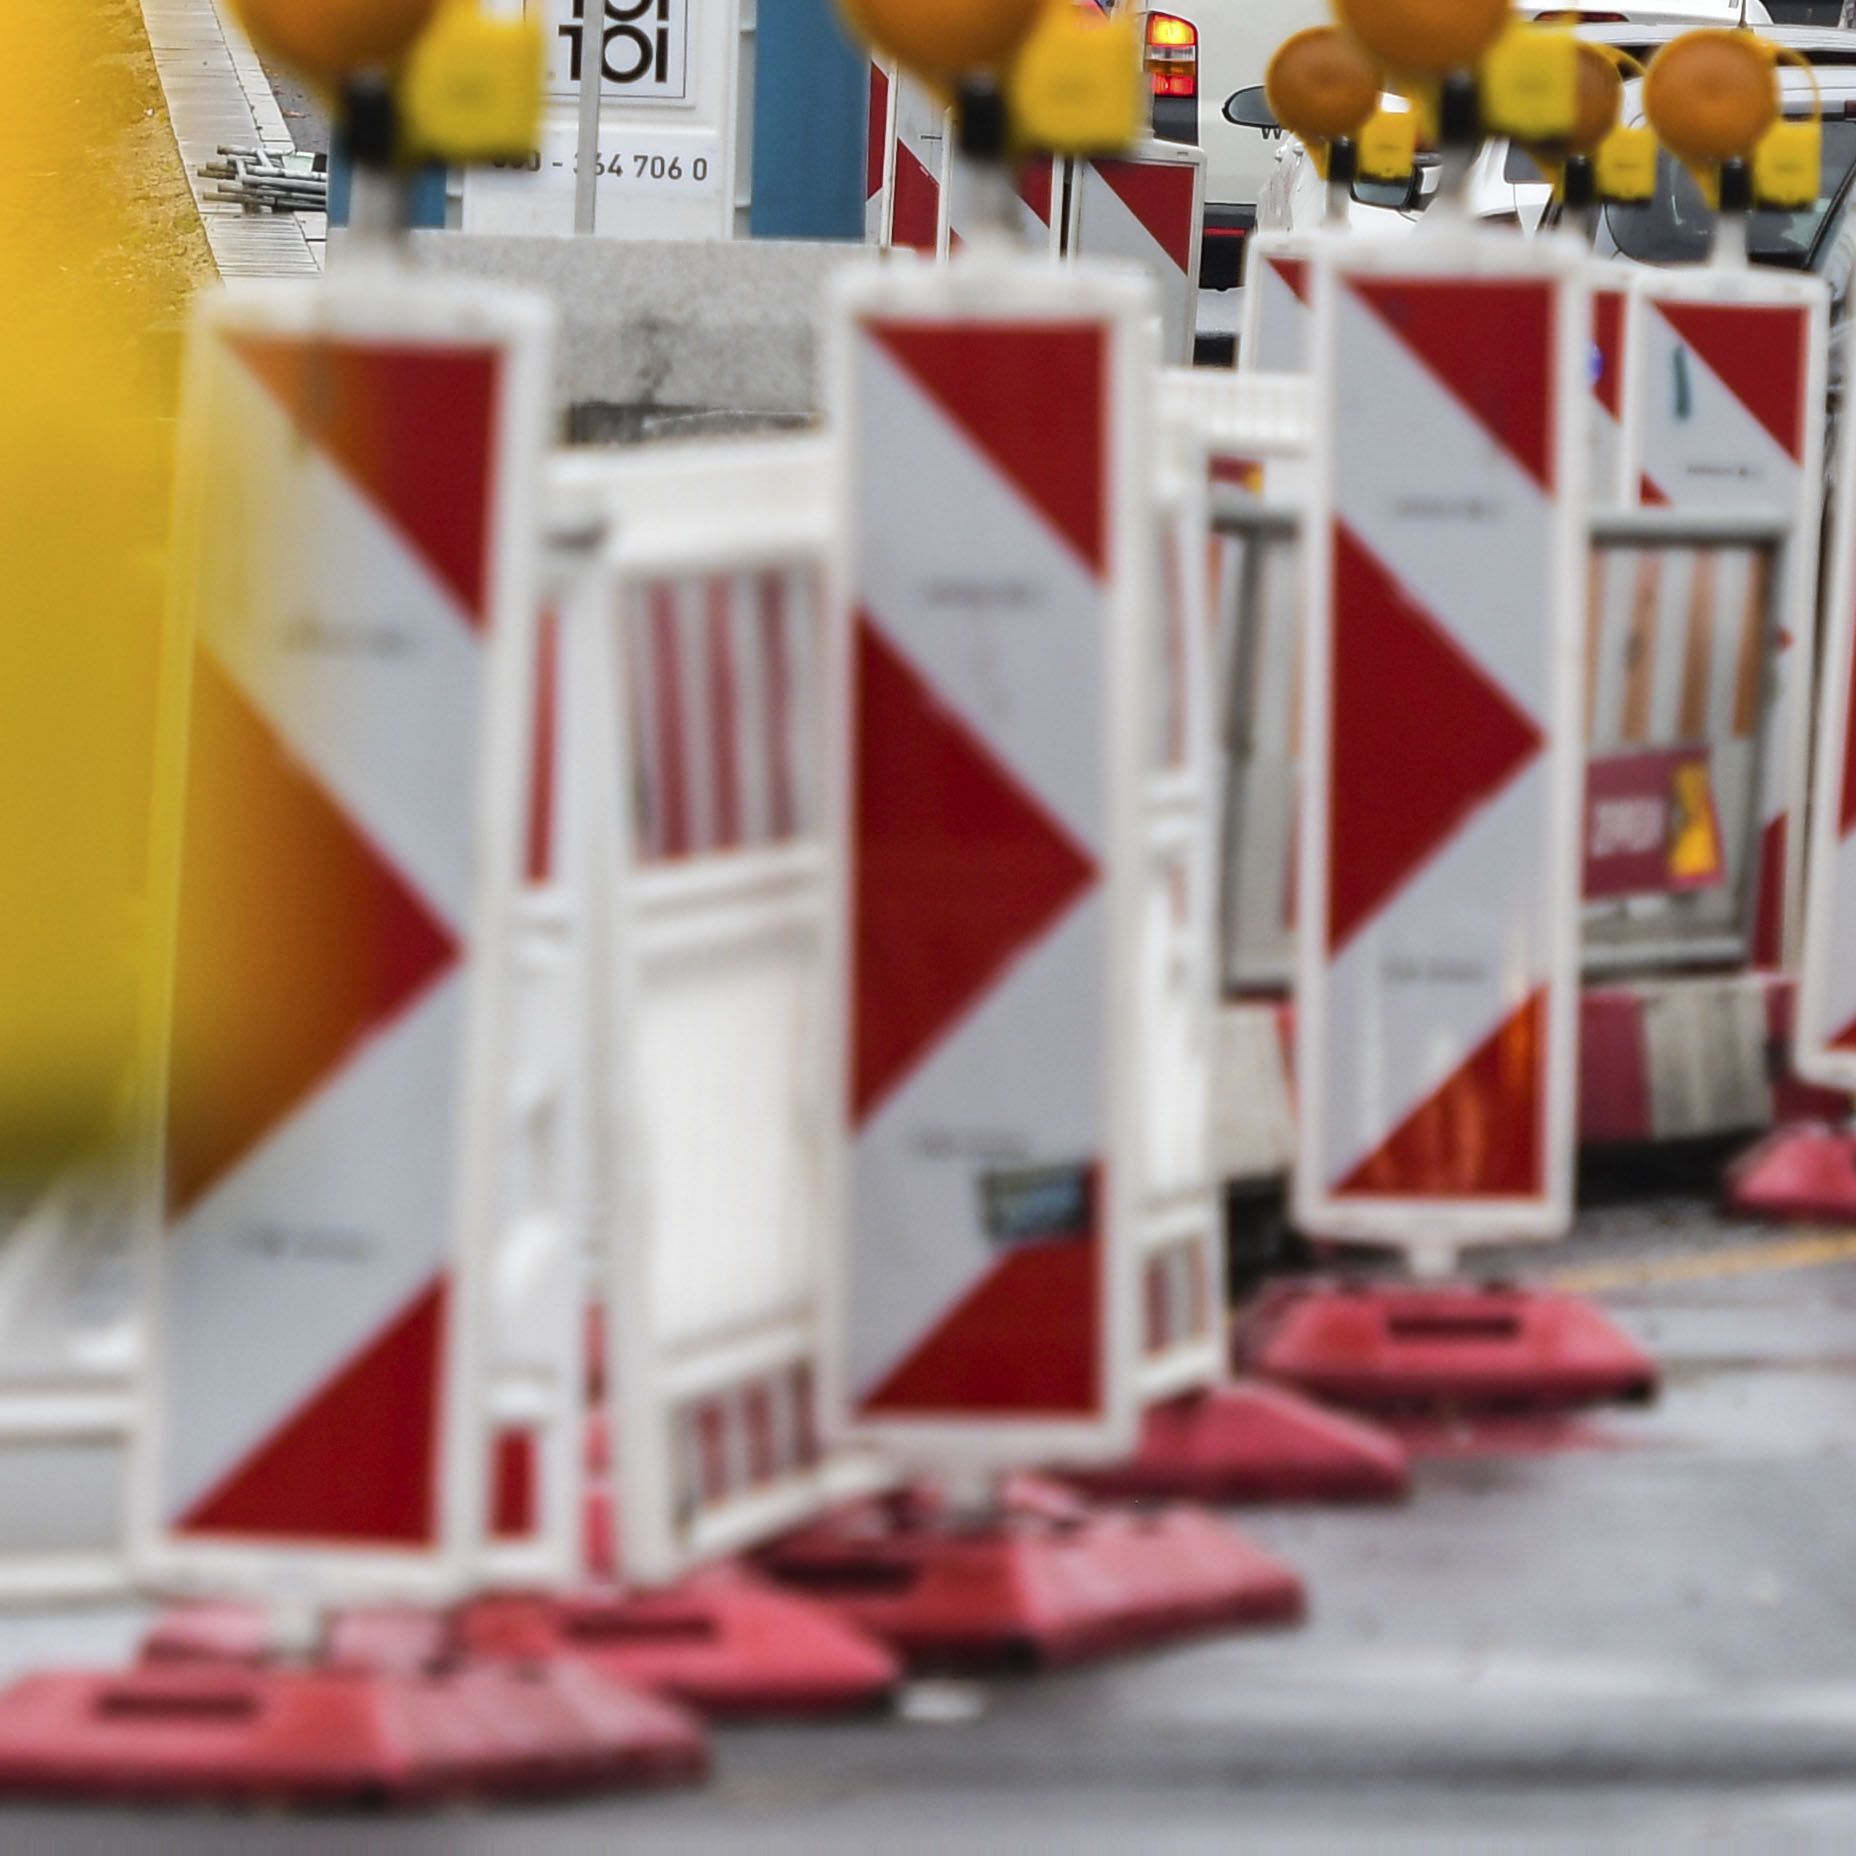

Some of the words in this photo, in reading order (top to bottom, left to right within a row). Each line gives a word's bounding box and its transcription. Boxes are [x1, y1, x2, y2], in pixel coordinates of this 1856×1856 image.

[573, 152, 623, 178] 64
[633, 155, 683, 180] 706
[693, 157, 708, 181] 0
